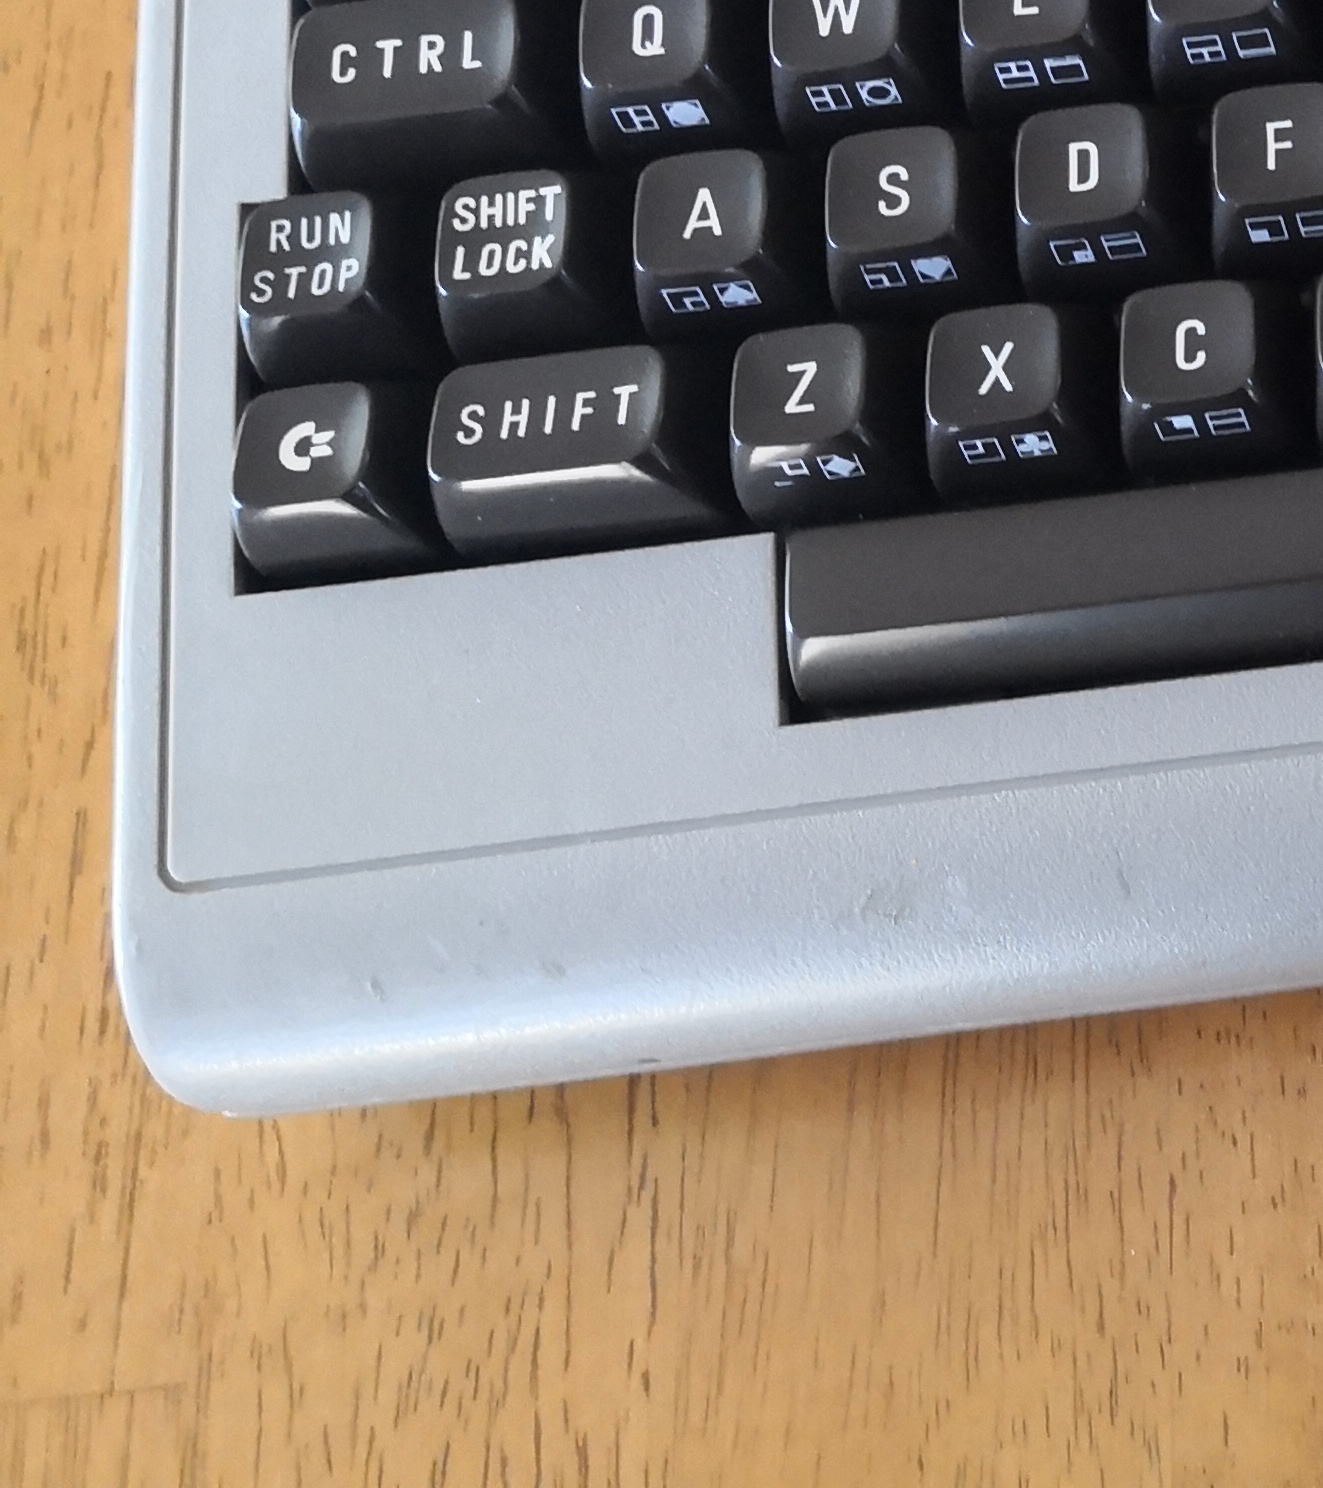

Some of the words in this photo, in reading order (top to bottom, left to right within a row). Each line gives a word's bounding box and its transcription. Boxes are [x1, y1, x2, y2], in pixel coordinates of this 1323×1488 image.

[331, 30, 483, 84] CTRL
[632, 4, 666, 57] Q
[1068, 141, 1100, 193] D
[1265, 119, 1293, 171] F
[452, 184, 563, 232] SHIFT
[682, 187, 723, 240] A
[878, 164, 910, 217] S
[269, 210, 352, 253] RUN
[248, 257, 361, 304] STOP
[452, 235, 555, 282] LOCK
[978, 341, 1015, 396] X
[1175, 318, 1207, 371] C
[784, 360, 818, 414] Z
[456, 383, 640, 445] SHIFT
